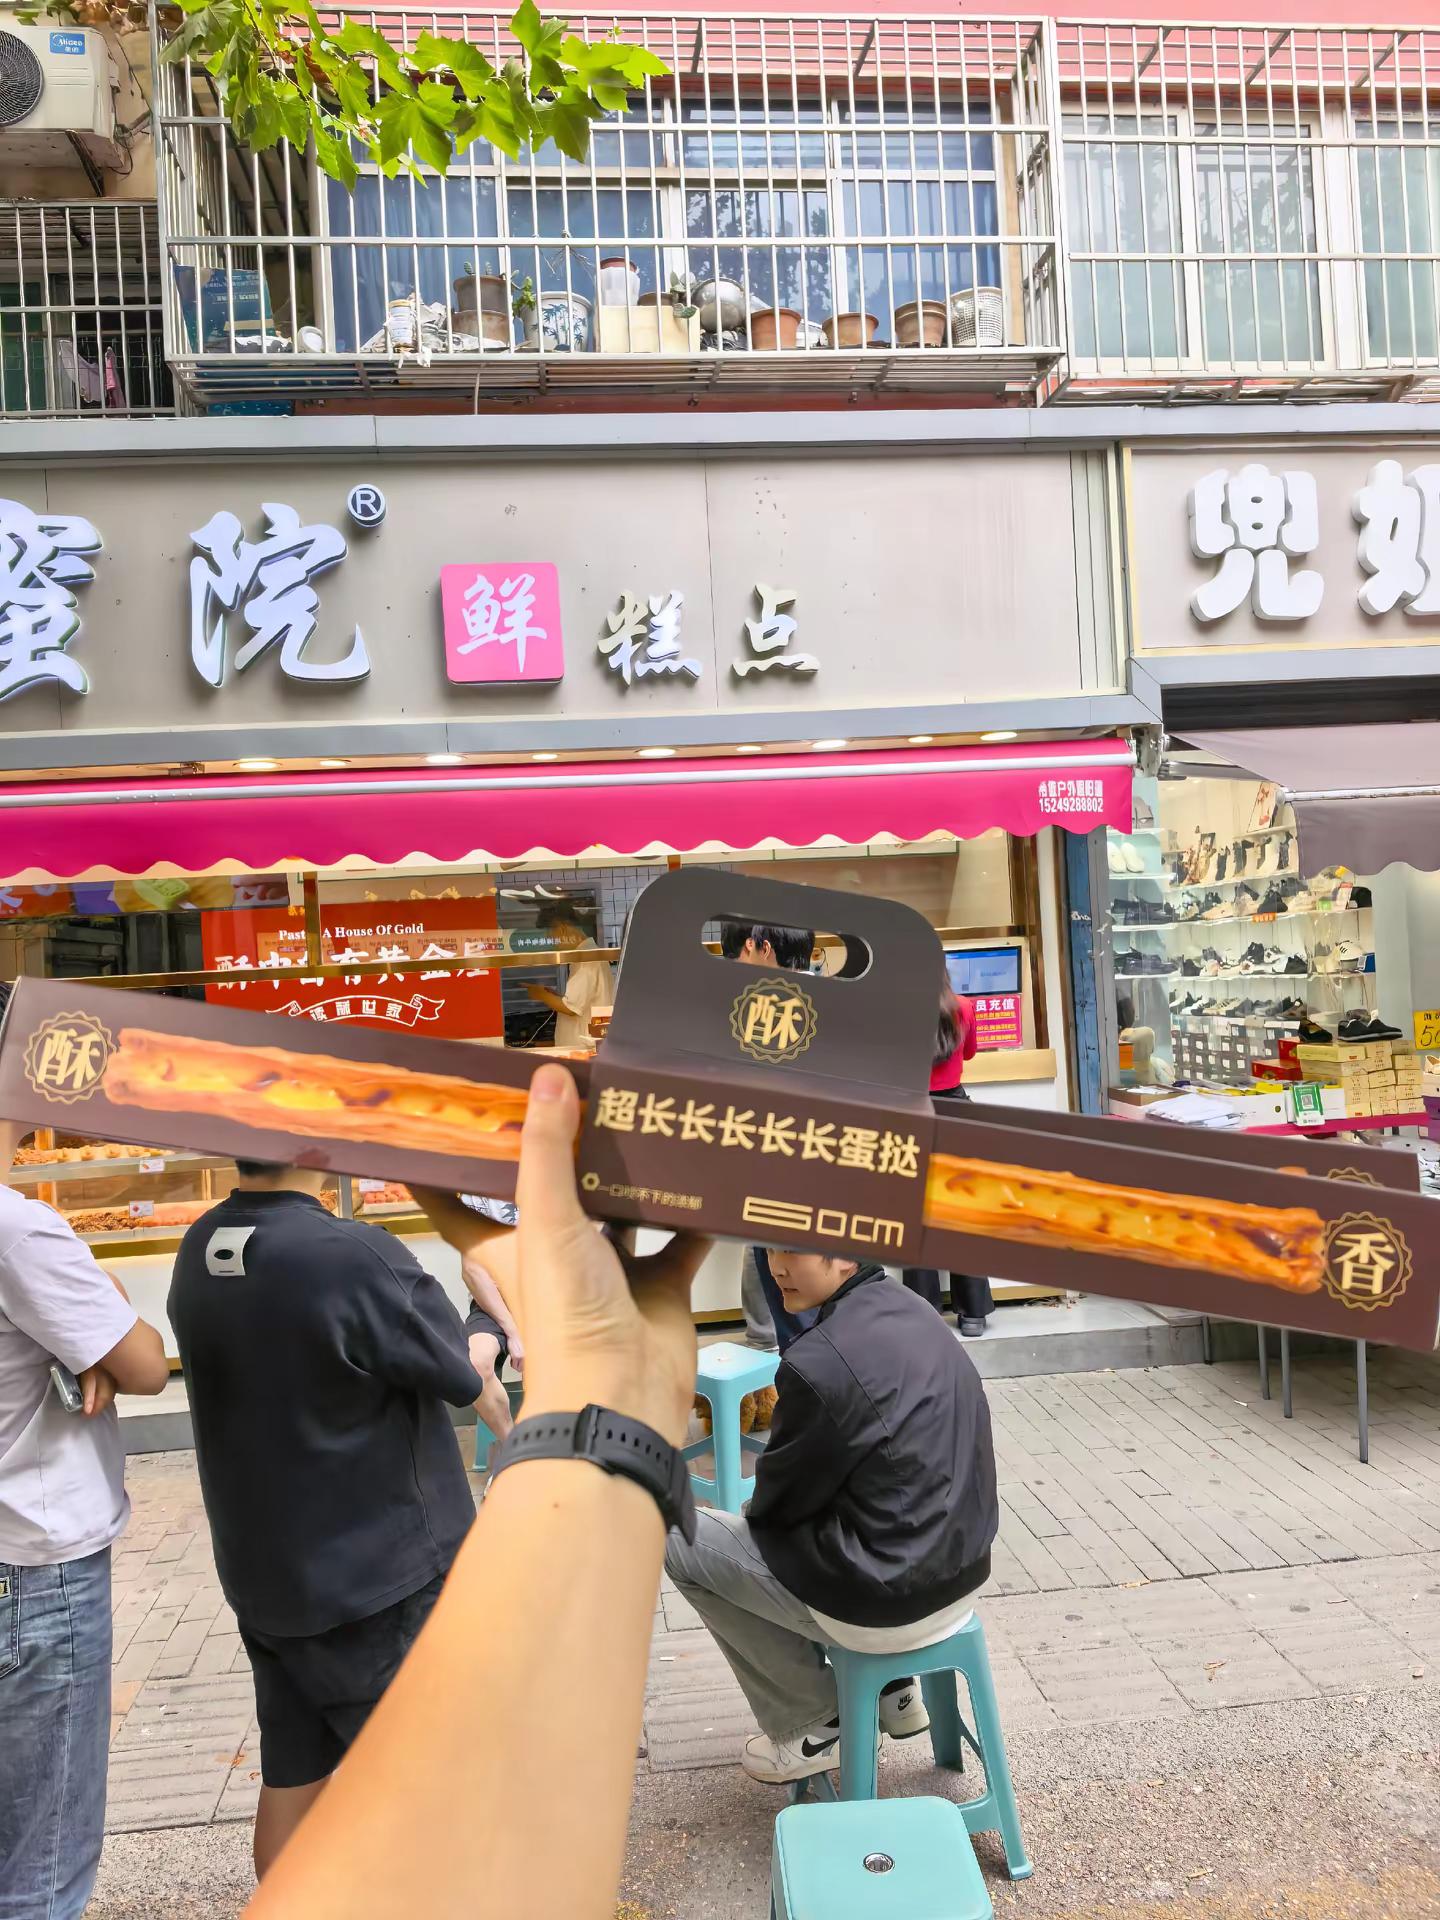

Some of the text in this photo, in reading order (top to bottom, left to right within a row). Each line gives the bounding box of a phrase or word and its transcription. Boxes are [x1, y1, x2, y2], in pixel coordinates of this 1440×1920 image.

[1039, 797, 1103, 812] 15249288802
[322, 928, 332, 938] A
[335, 925, 373, 938] House
[376, 925, 392, 936] Of
[394, 923, 424, 935] Gold
[744, 993, 803, 1049] 酥
[976, 998, 1015, 1012] 员充值
[36, 1028, 101, 1089] 酥
[594, 1087, 920, 1178] 超长长长长长蛋挞
[1332, 1233, 1395, 1294] 香
